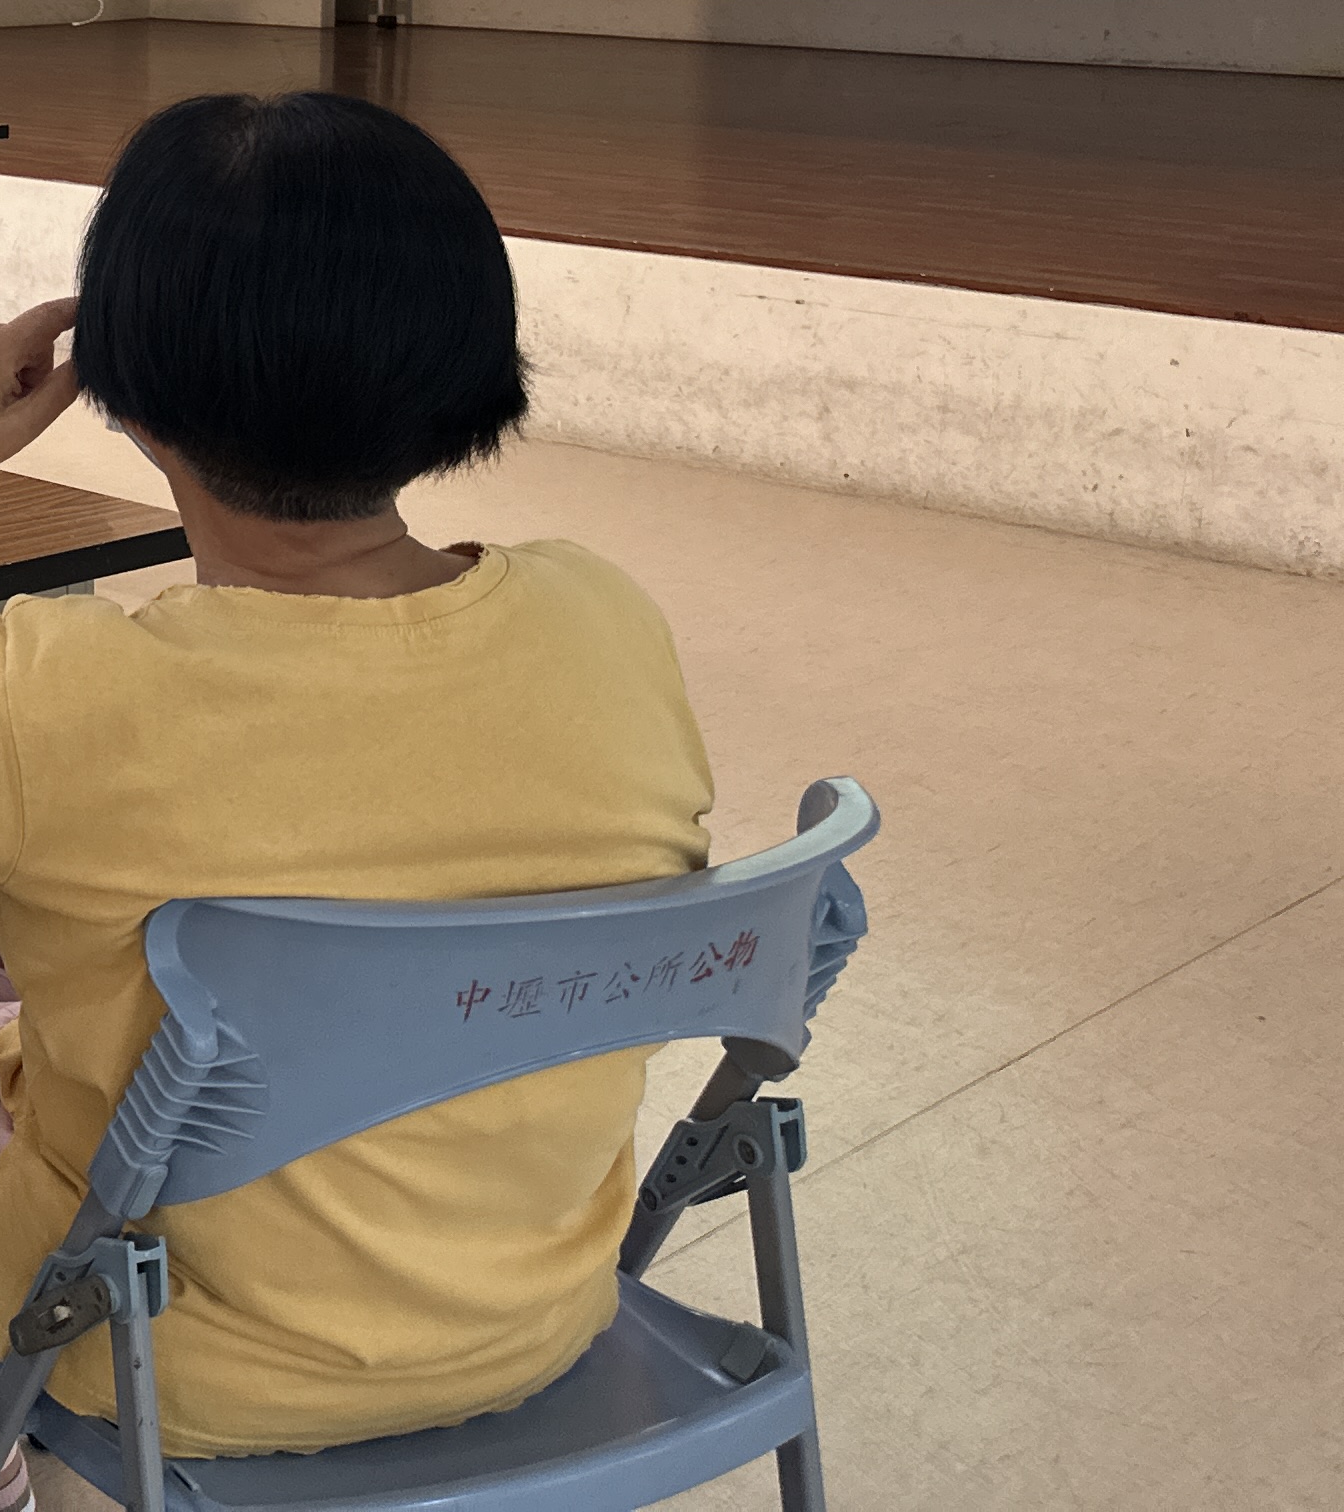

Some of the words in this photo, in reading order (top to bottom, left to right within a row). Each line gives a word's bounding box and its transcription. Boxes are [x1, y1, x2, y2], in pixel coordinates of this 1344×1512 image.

[456, 928, 760, 1023] 中壢市公所公物
